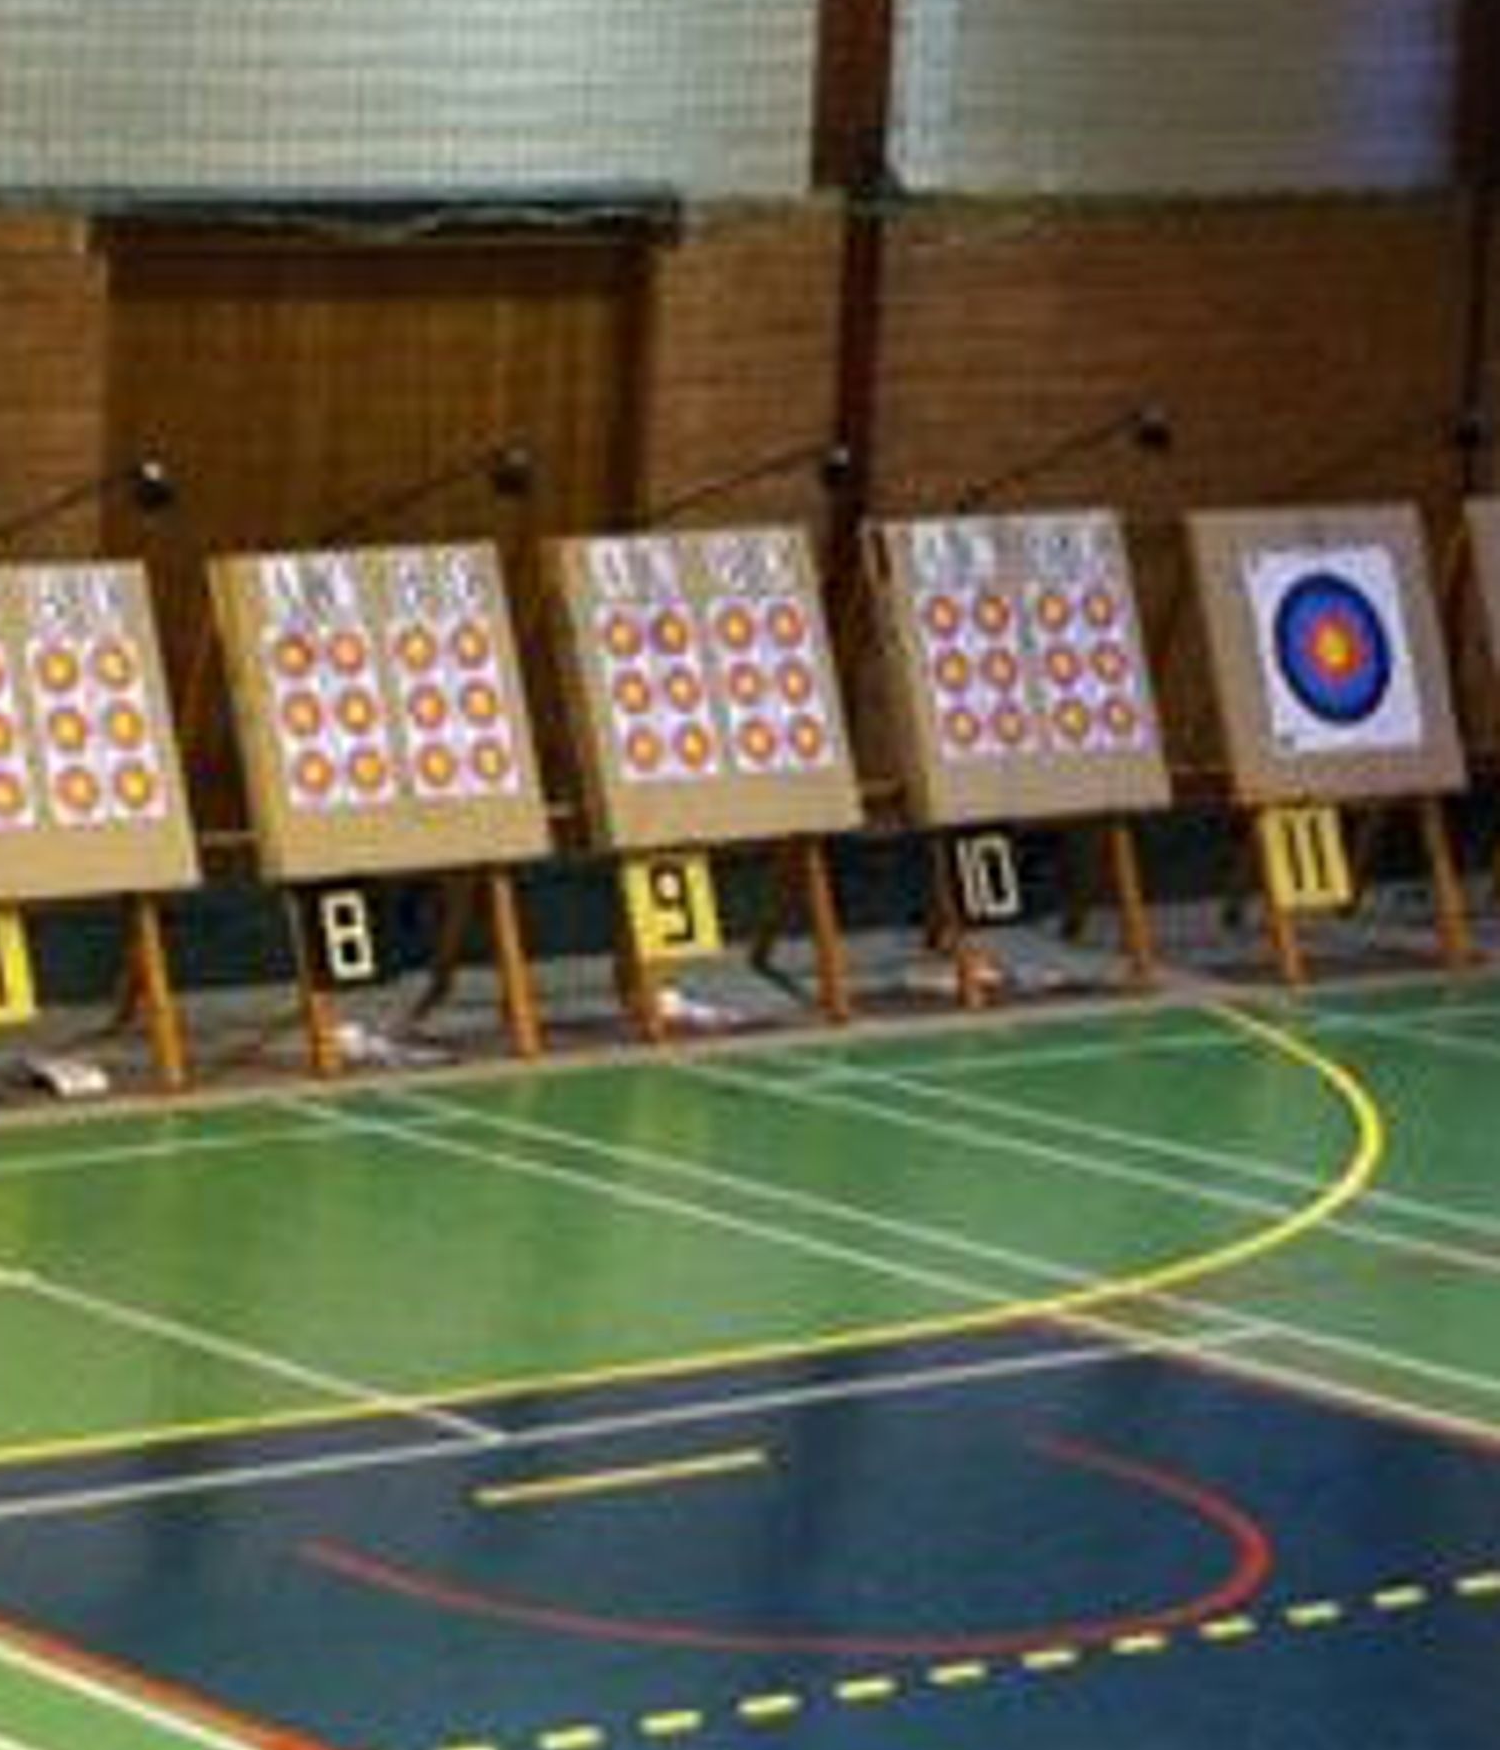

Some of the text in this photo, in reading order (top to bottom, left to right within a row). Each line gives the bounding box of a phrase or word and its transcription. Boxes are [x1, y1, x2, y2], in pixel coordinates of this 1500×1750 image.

[956, 834, 1019, 920] 10
[1281, 816, 1332, 891] 11
[320, 890, 374, 980] 8
[650, 862, 695, 943] 9
